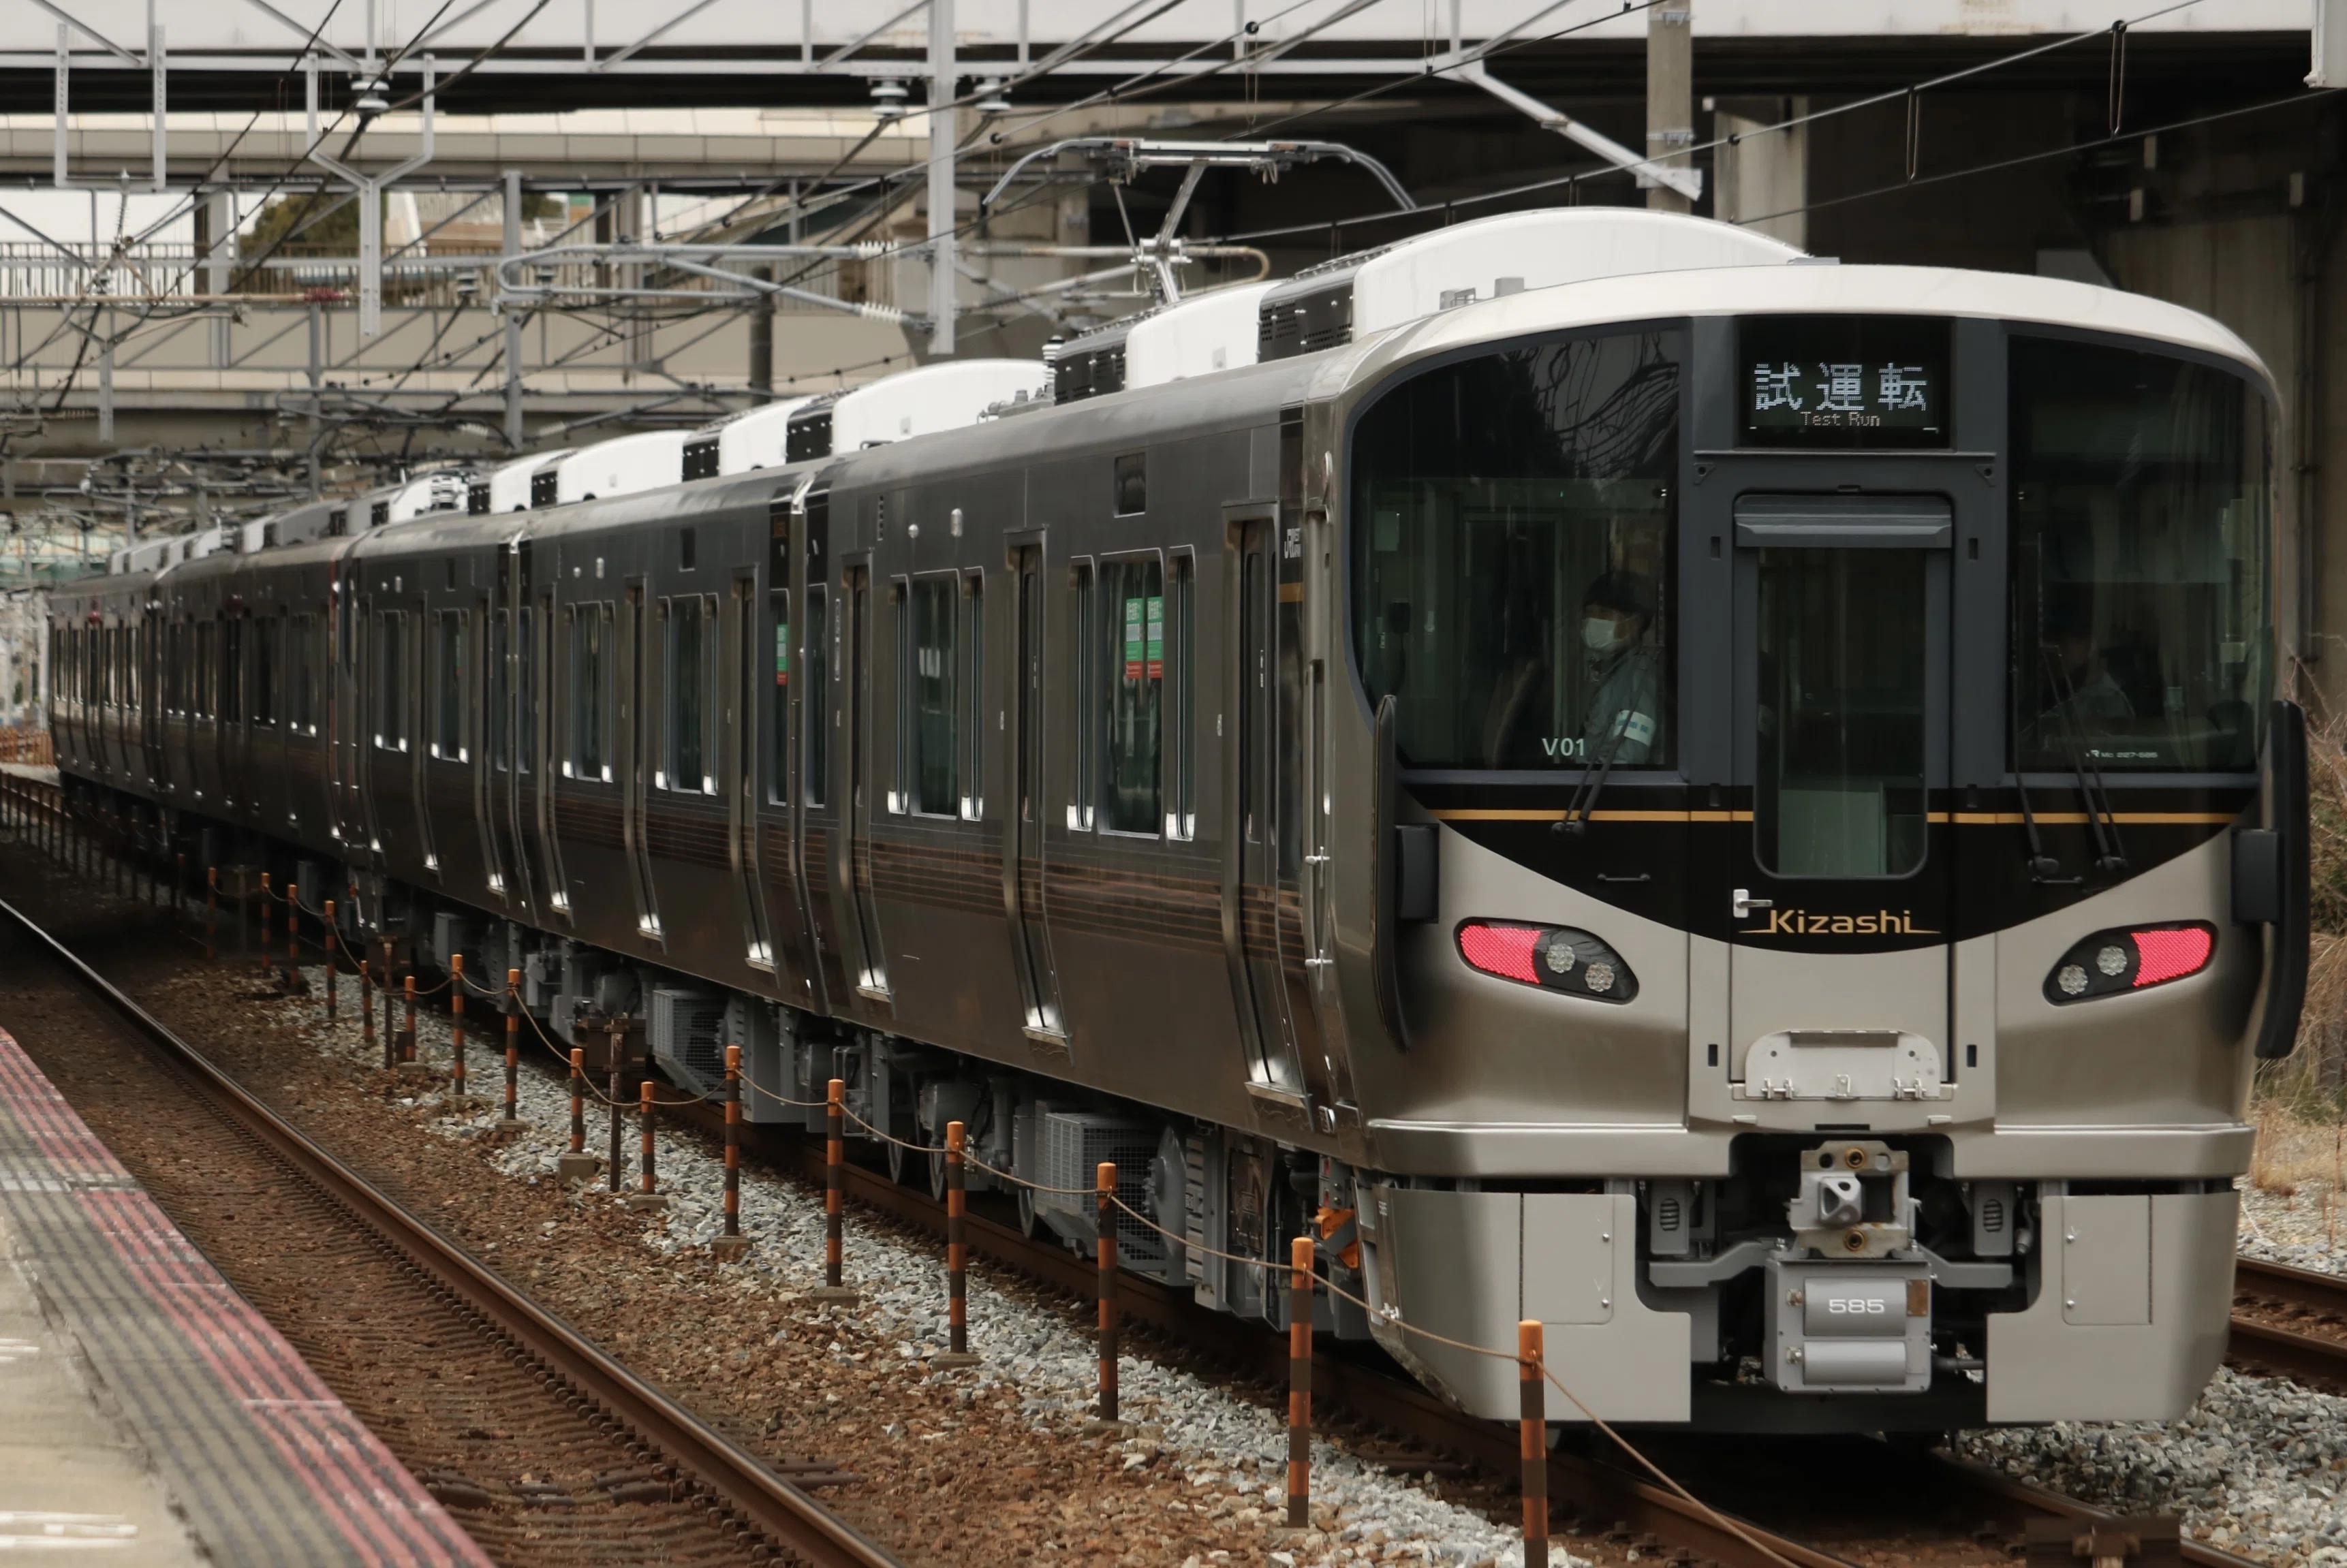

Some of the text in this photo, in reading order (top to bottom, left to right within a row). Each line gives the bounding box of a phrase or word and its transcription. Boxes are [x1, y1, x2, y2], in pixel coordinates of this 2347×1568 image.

[1754, 362, 1927, 410] 試運転
[1801, 411, 1880, 426] Test Run
[1541, 738, 1585, 756] V01
[1739, 909, 1941, 934] Kizashi
[1828, 1299, 1885, 1315] 585
